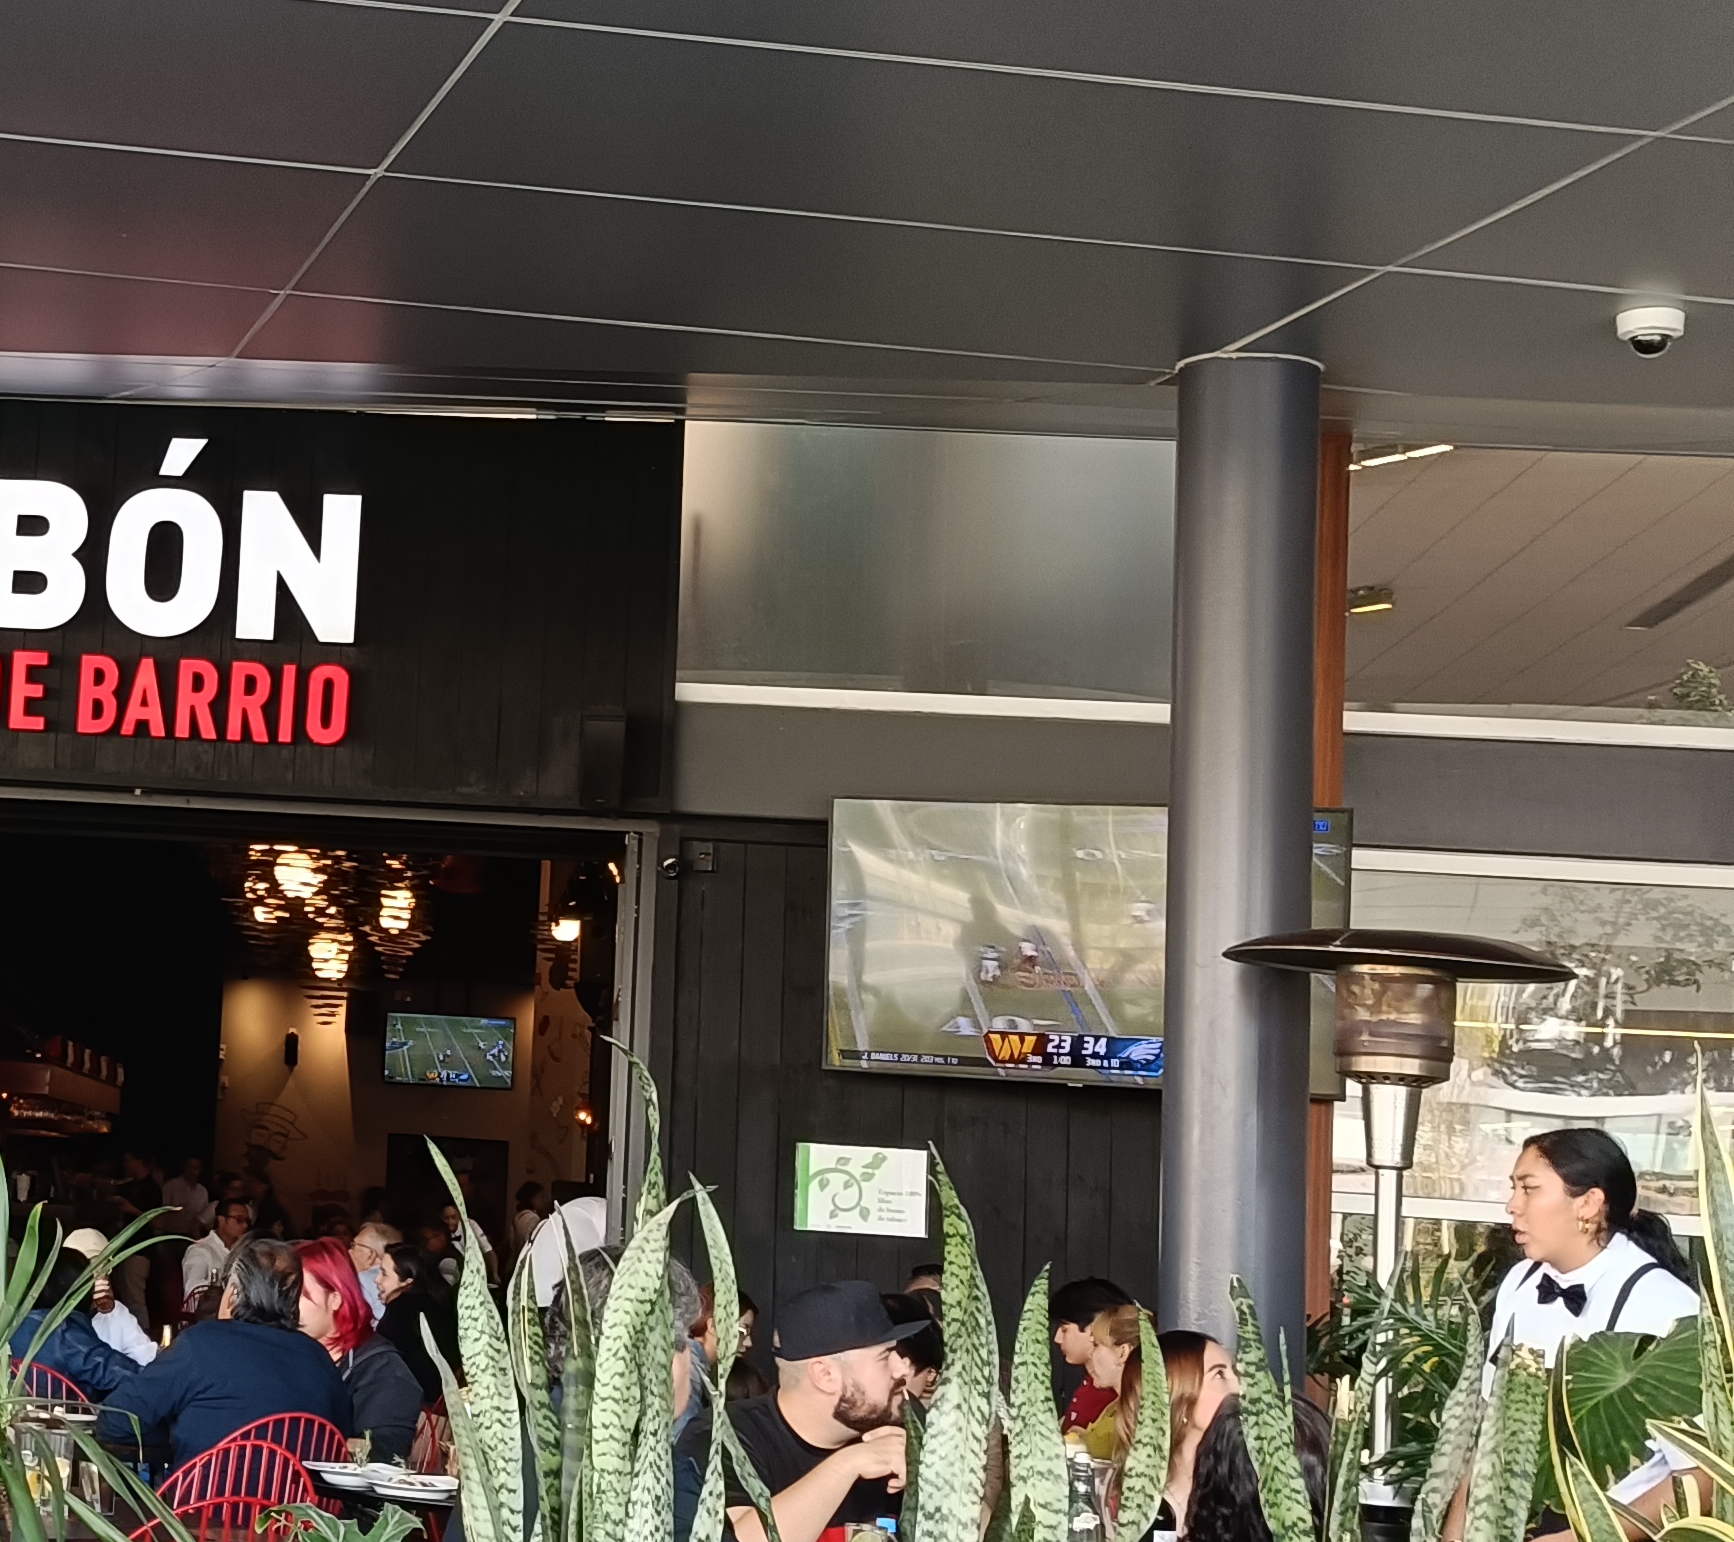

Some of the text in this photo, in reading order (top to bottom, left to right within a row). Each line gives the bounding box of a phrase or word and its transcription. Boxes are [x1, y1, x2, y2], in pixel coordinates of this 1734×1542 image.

[76, 652, 351, 746] BARRIO
[1046, 1035, 1107, 1056] 23 34
